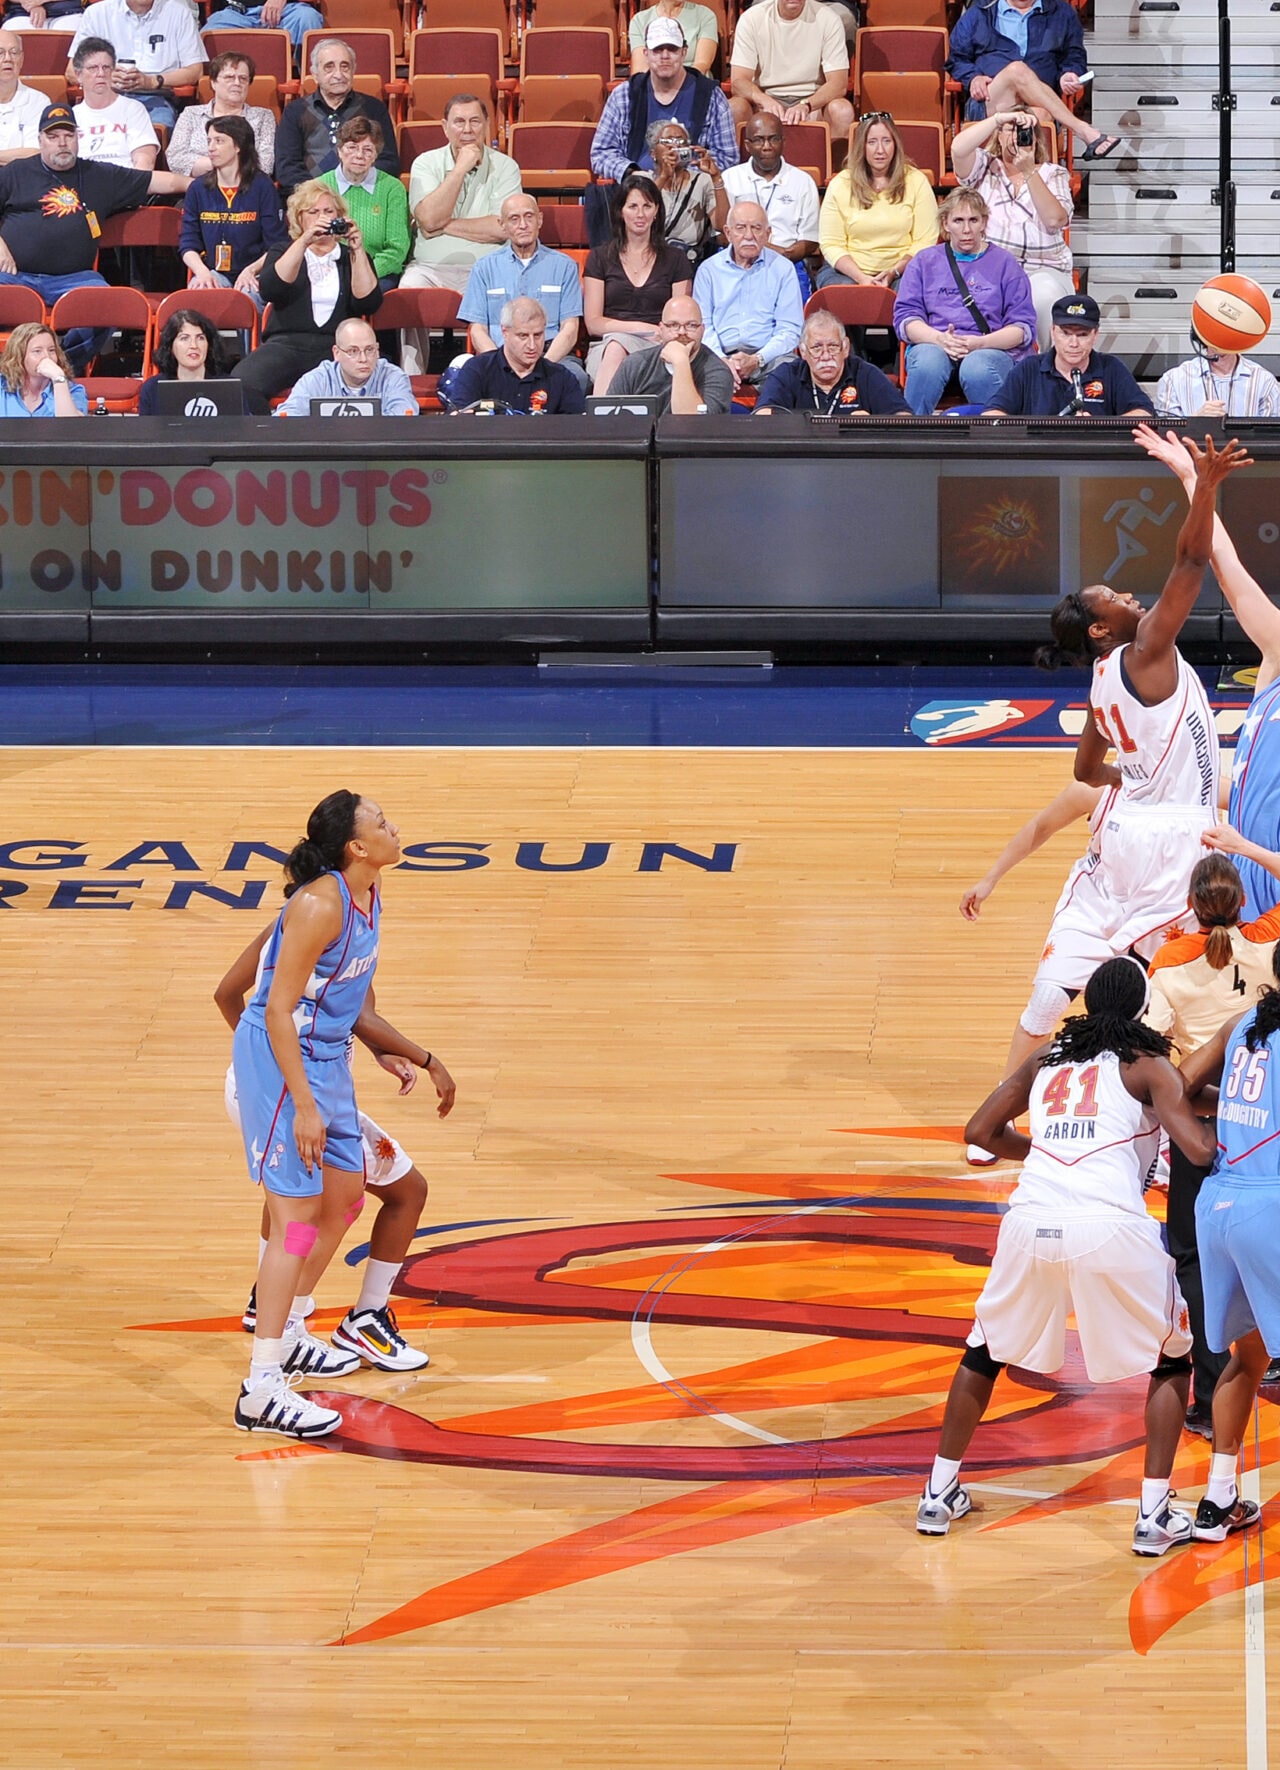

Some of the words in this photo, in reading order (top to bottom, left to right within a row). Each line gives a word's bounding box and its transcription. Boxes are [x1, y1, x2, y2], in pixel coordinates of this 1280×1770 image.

[0, 469, 115, 526] IN'
[30, 549, 122, 593] ON
[150, 549, 414, 593] DUNKIN'
[393, 842, 742, 872] SUN
[1233, 963, 1247, 996] 4
[1042, 1064, 1100, 1117] 41
[1226, 1045, 1270, 1103] 35
[1044, 1120, 1096, 1140] GARDIN
